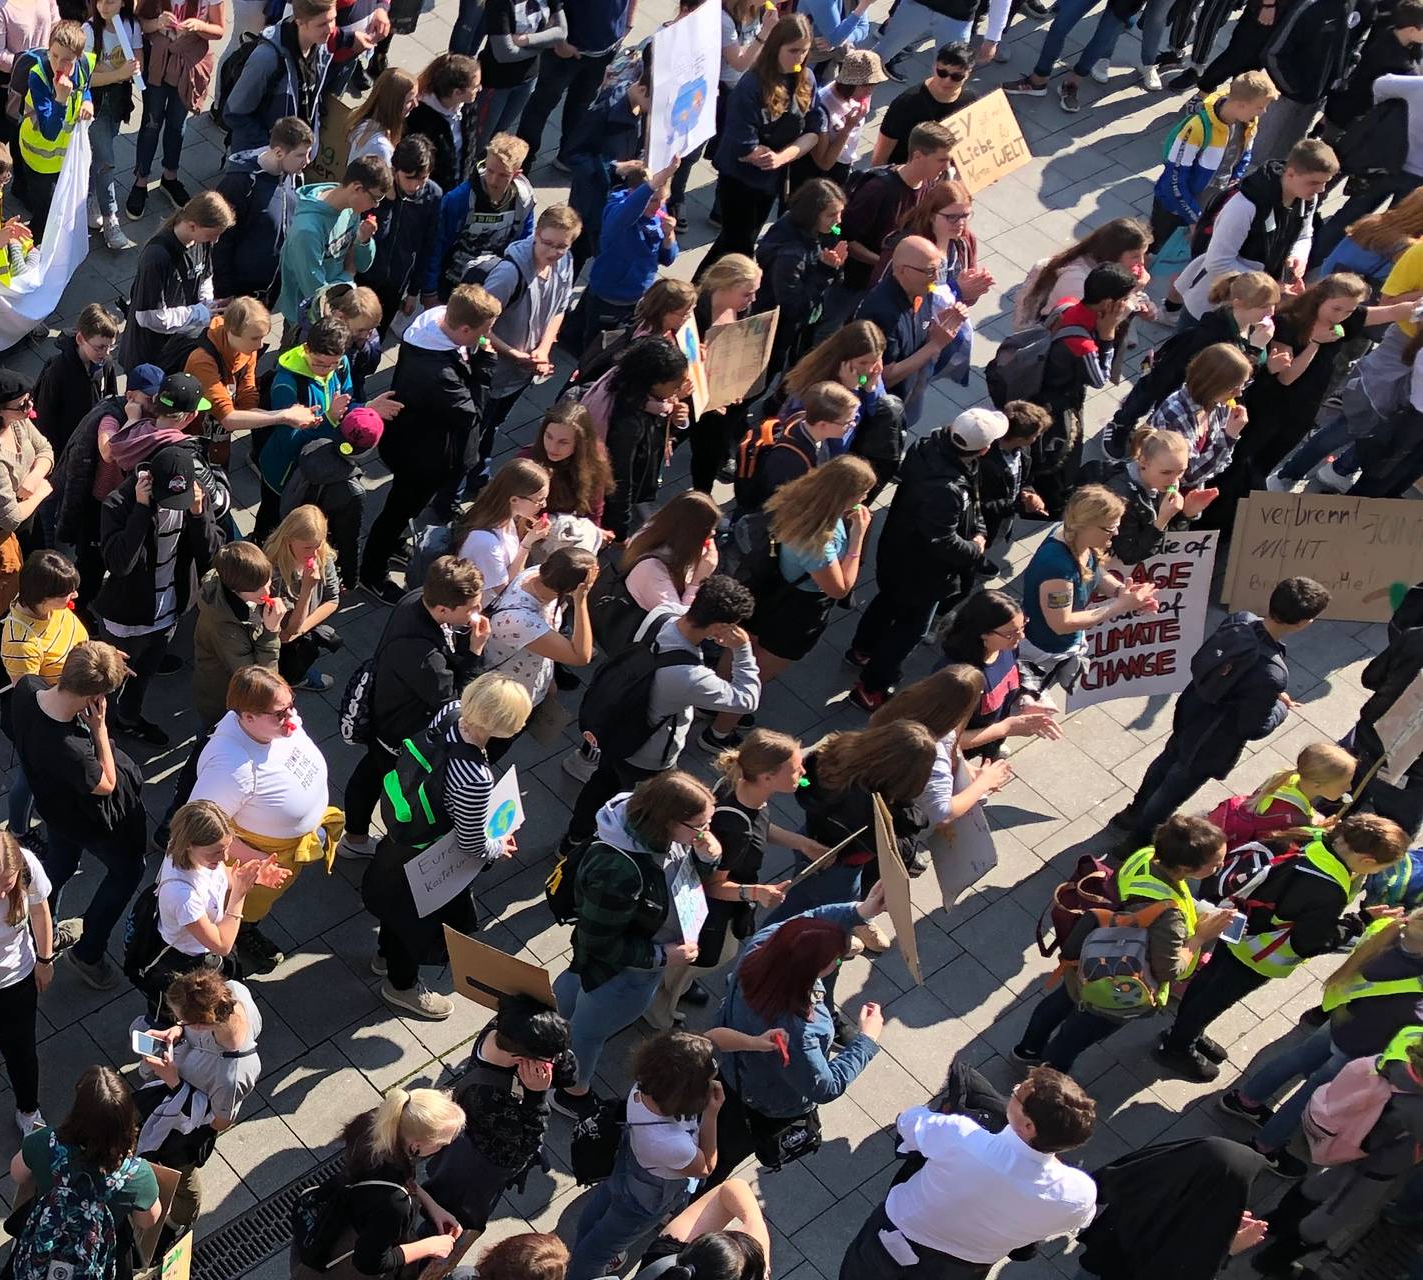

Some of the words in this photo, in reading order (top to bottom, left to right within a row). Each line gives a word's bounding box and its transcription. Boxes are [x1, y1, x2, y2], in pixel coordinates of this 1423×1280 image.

[957, 138, 995, 166] Liebe
[992, 136, 1025, 168] WELT
[1260, 498, 1361, 527] verbrennt
[1185, 534, 1213, 558] of
[1251, 539, 1329, 561] NICHT
[1131, 561, 1194, 590] AGE
[1157, 592, 1187, 618] of
[1080, 649, 1177, 691] CHANGE
[283, 746, 303, 772] POWER
[298, 754, 311, 771] THE
[293, 767, 305, 780] TO
[300, 762, 320, 791] PEOPLE
